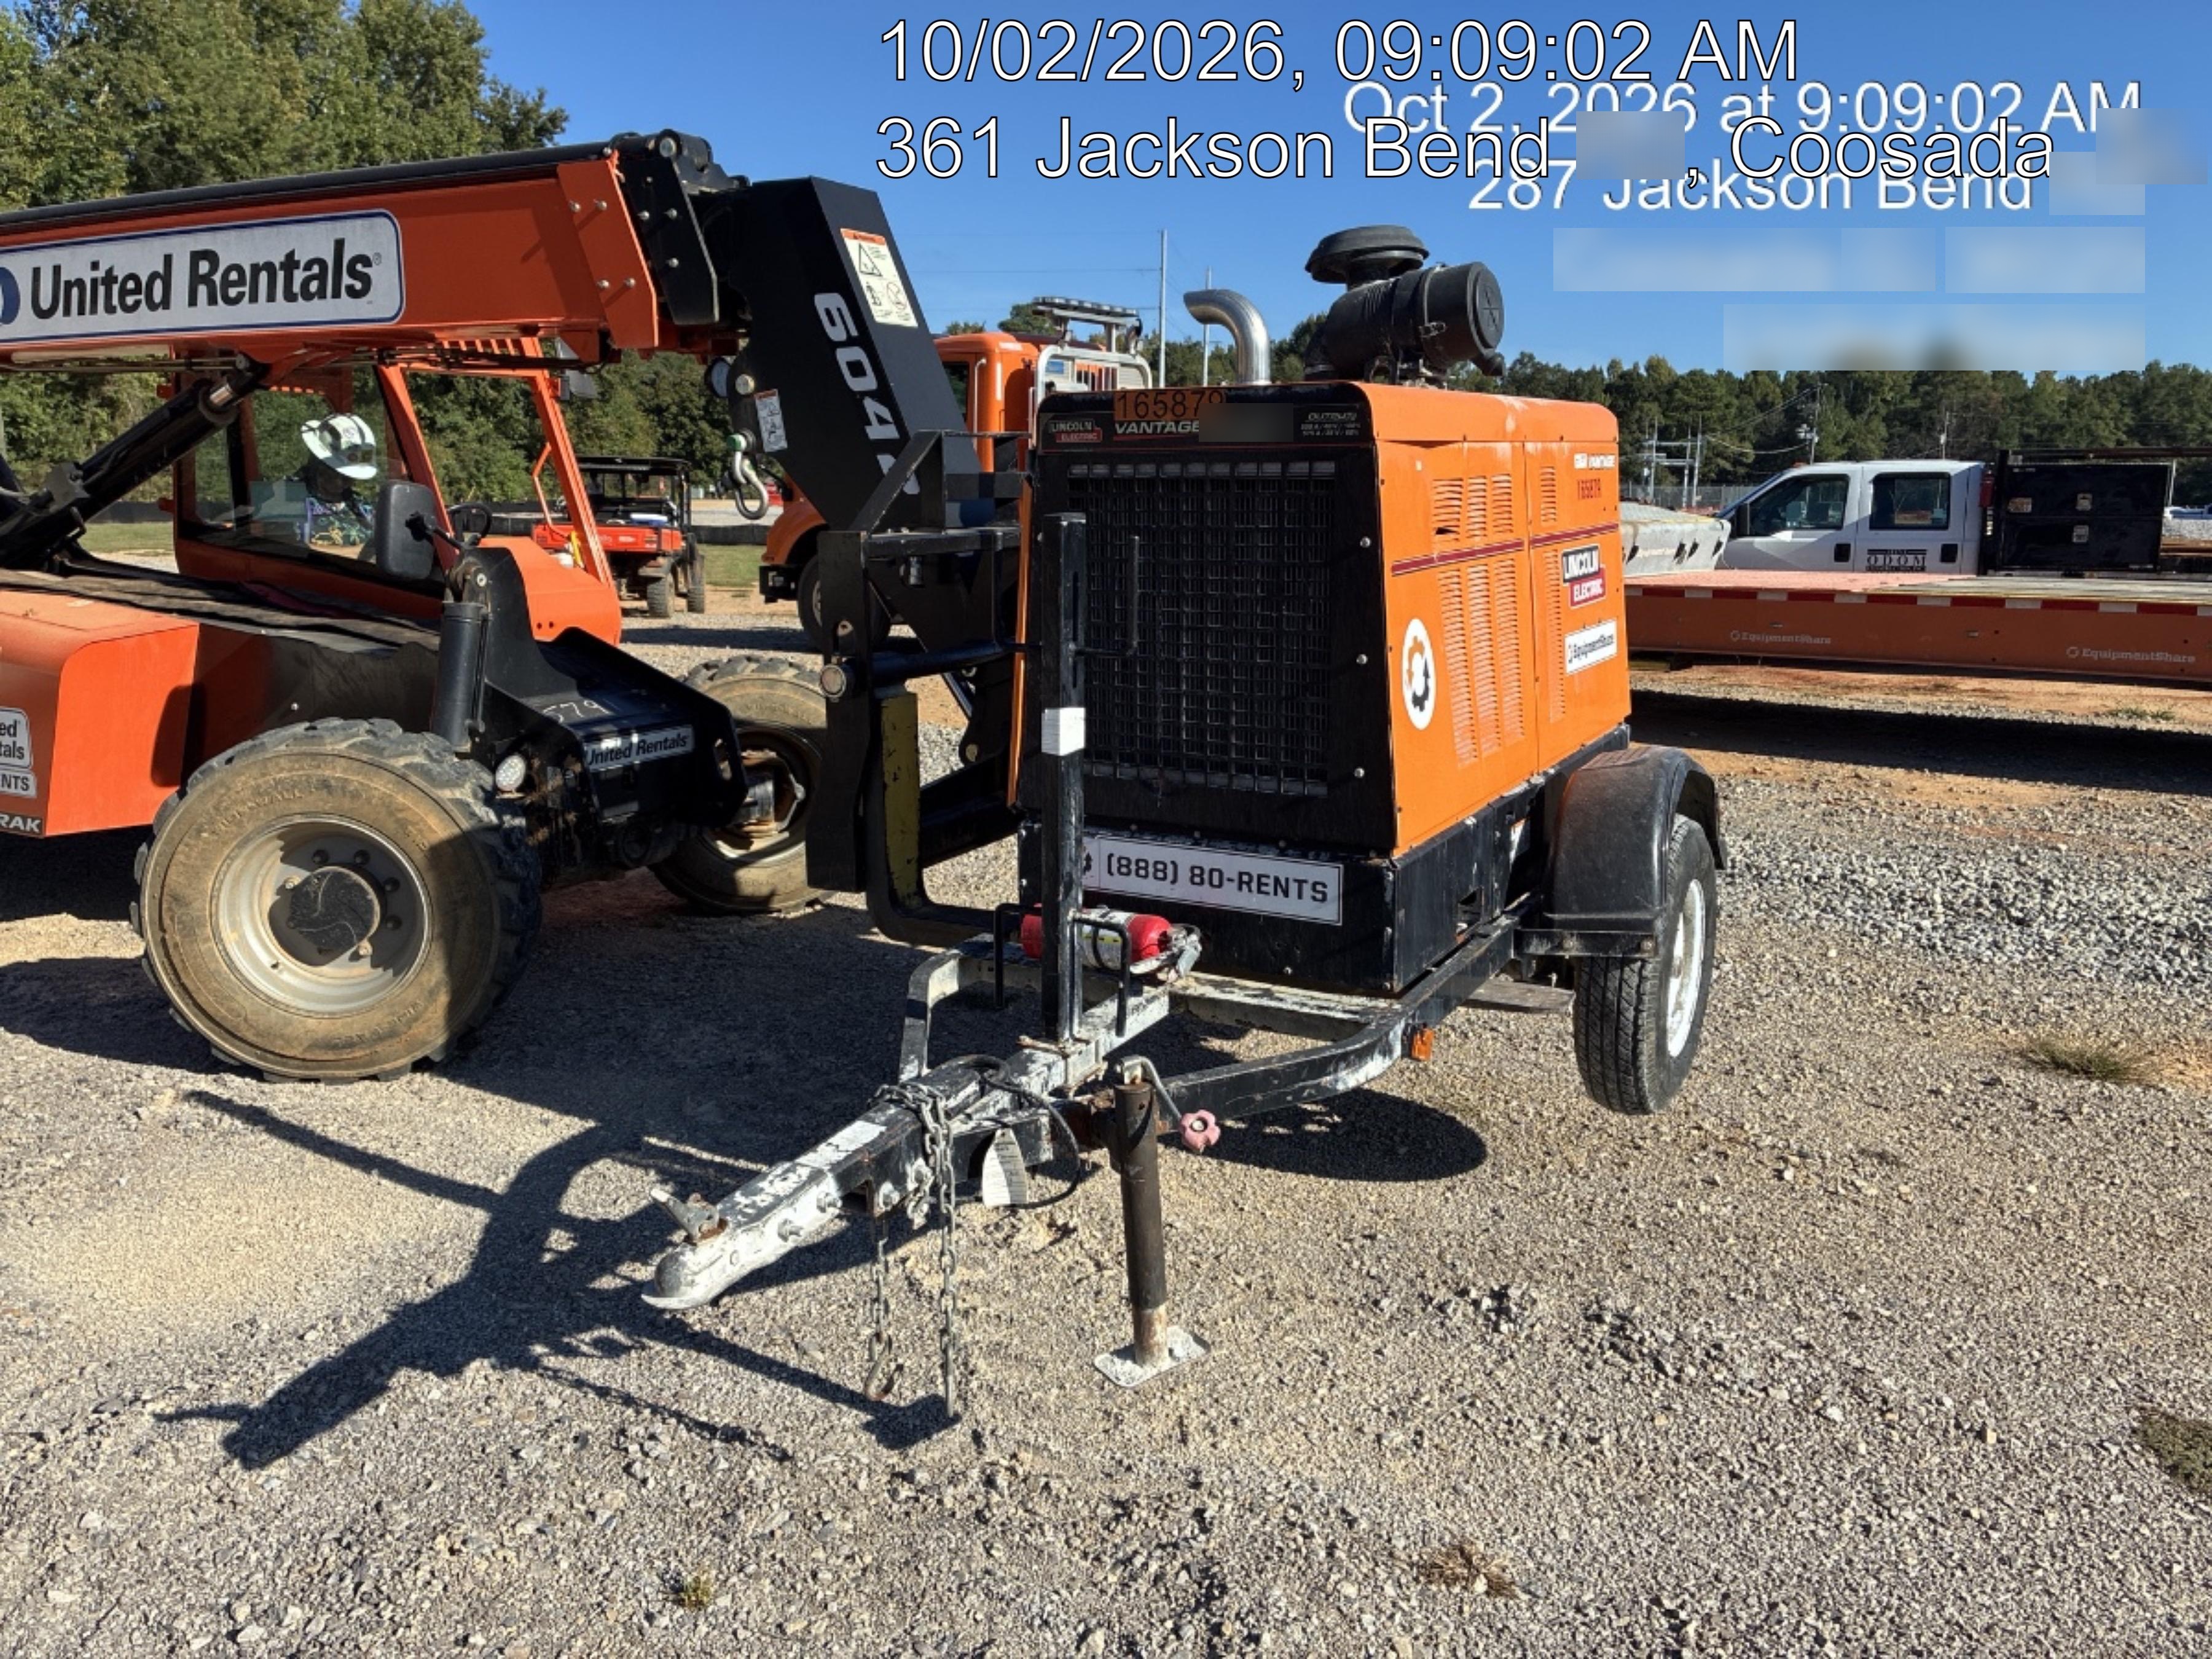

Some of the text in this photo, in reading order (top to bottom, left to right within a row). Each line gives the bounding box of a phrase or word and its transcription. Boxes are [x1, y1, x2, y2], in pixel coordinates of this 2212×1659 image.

[31, 238, 373, 320] United Rentals
[1115, 421, 1199, 434] VANTAGE
[2082, 648, 2196, 663] EquipmentShare
[637, 733, 688, 756] Rentals
[1107, 853, 1328, 904] (888) 80-RENTS
